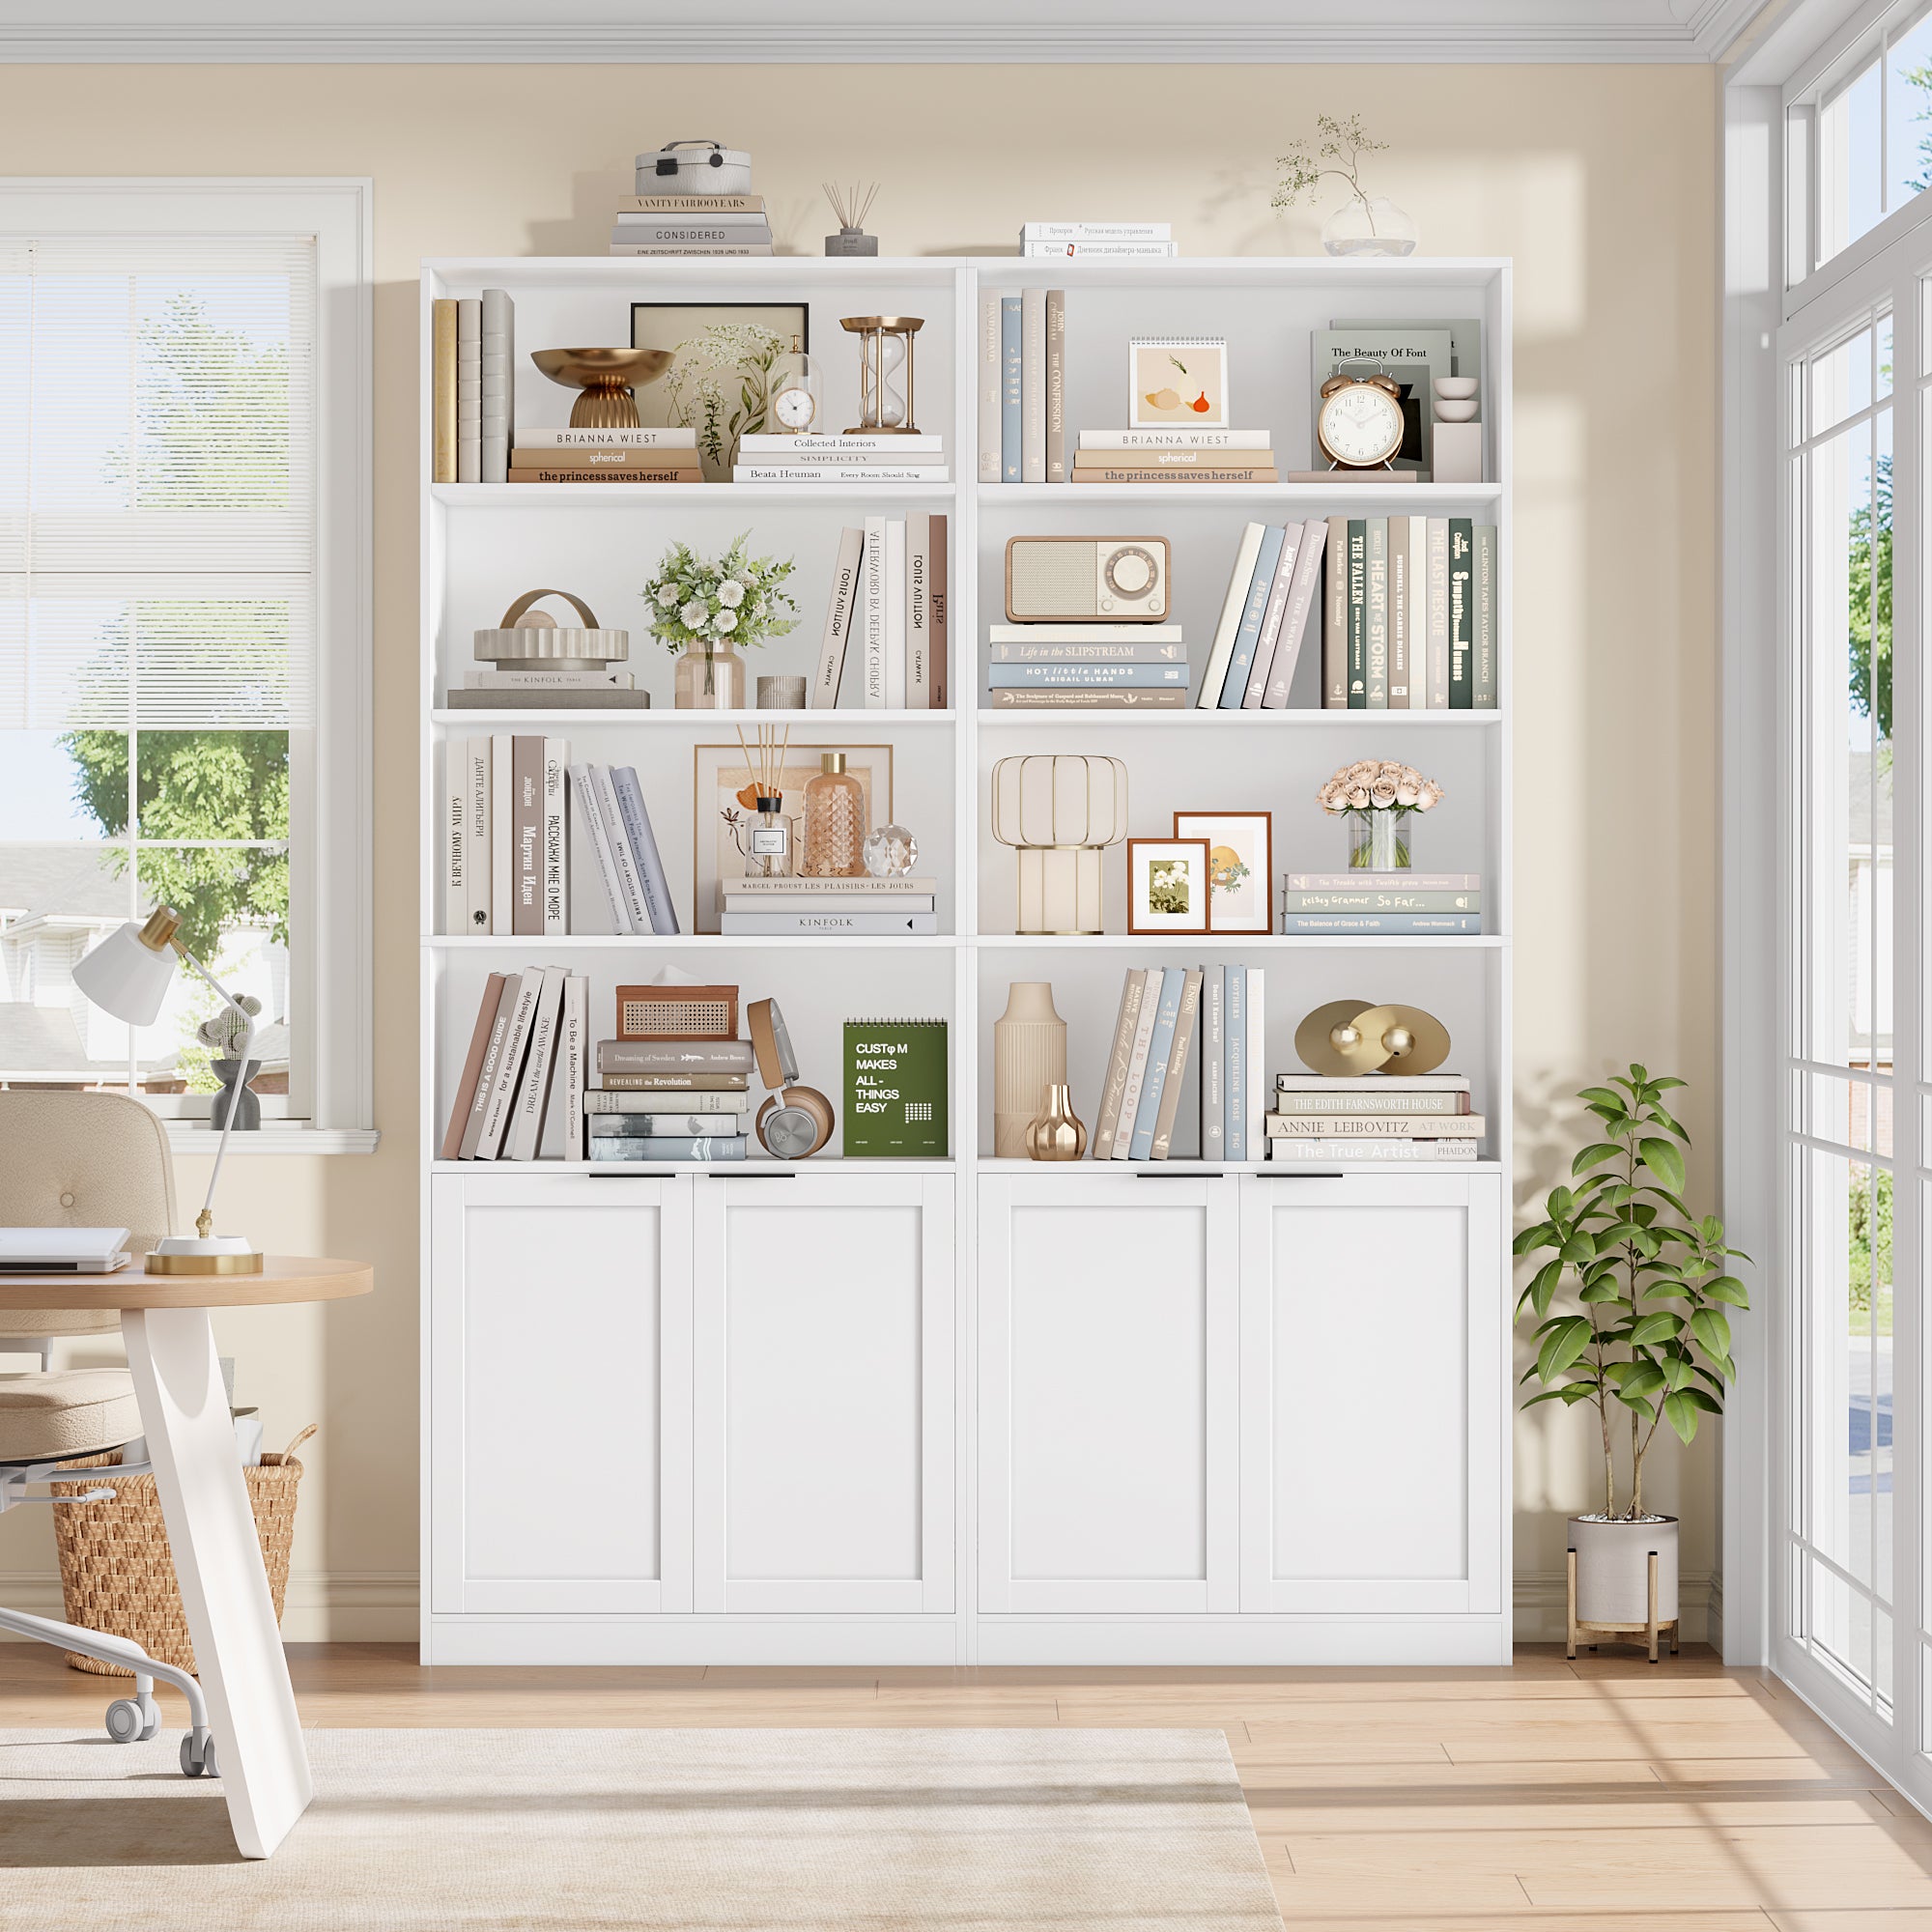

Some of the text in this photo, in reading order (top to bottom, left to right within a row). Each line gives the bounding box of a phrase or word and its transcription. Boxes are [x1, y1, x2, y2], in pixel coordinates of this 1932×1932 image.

[1331, 348, 1427, 359] The Beauty Of Font
[1052, 369, 1062, 433] CONFESSION
[794, 439, 876, 447] Collected Interiors
[1122, 436, 1229, 444] BRIANNA WIEST
[589, 452, 626, 465] spherical
[1159, 452, 1196, 464] spherical
[539, 471, 679, 483] the princess saves herself
[751, 469, 777, 478] Beata
[780, 469, 821, 478] Heuman
[1105, 470, 1124, 480] the
[1126, 470, 1177, 483] princess
[1211, 470, 1254, 480] herself
[1352, 535, 1364, 559] THE
[1432, 528, 1445, 553] THE
[1352, 562, 1364, 605] FALLEN
[1432, 556, 1445, 587] LAST
[1372, 560, 1384, 612] HEART
[1432, 589, 1445, 636] RESCUE
[1020, 647, 1134, 659] Life in the SLIPSTREAM
[1372, 624, 1384, 678] STORM
[474, 757, 484, 788] ДАНТЕ
[452, 796, 462, 827] МИРУ
[452, 830, 462, 877] ВЕЧНОМУ
[521, 826, 537, 904] Мартин Иден
[548, 815, 560, 921] РАССКАЖИ МНЕ МОРЕ
[616, 842, 641, 915] BRIEF HISTORY TIME
[1377, 895, 1391, 907] So
[1131, 985, 1141, 1013] MAEVE
[1185, 984, 1197, 1012] ENON
[569, 1018, 578, 1029] To
[498, 1080, 508, 1092] for
[506, 1024, 524, 1070] sustainable
[517, 991, 532, 1023] lifestyle
[569, 1031, 578, 1043] Be
[475, 1016, 506, 1111] THIS IS A GOOD GUIDE
[526, 1016, 551, 1114] DREAM AWAKE
[569, 1053, 578, 1090] Machine
[856, 1060, 897, 1069] MAKES
[1124, 1026, 1149, 1120] THE LOOP
[1231, 1036, 1239, 1093] JACQUELINE
[856, 1076, 877, 1086] ALL
[1151, 1061, 1168, 1098] Kate
[856, 1090, 899, 1099] THINGS
[1294, 1098, 1443, 1109] THE EDITH FARNSWORTH HOUSE
[856, 1102, 887, 1113] EASY
[1278, 1122, 1476, 1132] ANNIE LEIBOVITZ AT WORK
[1294, 1145, 1420, 1158] The True Artist
[1437, 1147, 1476, 1155] PHAIDON
